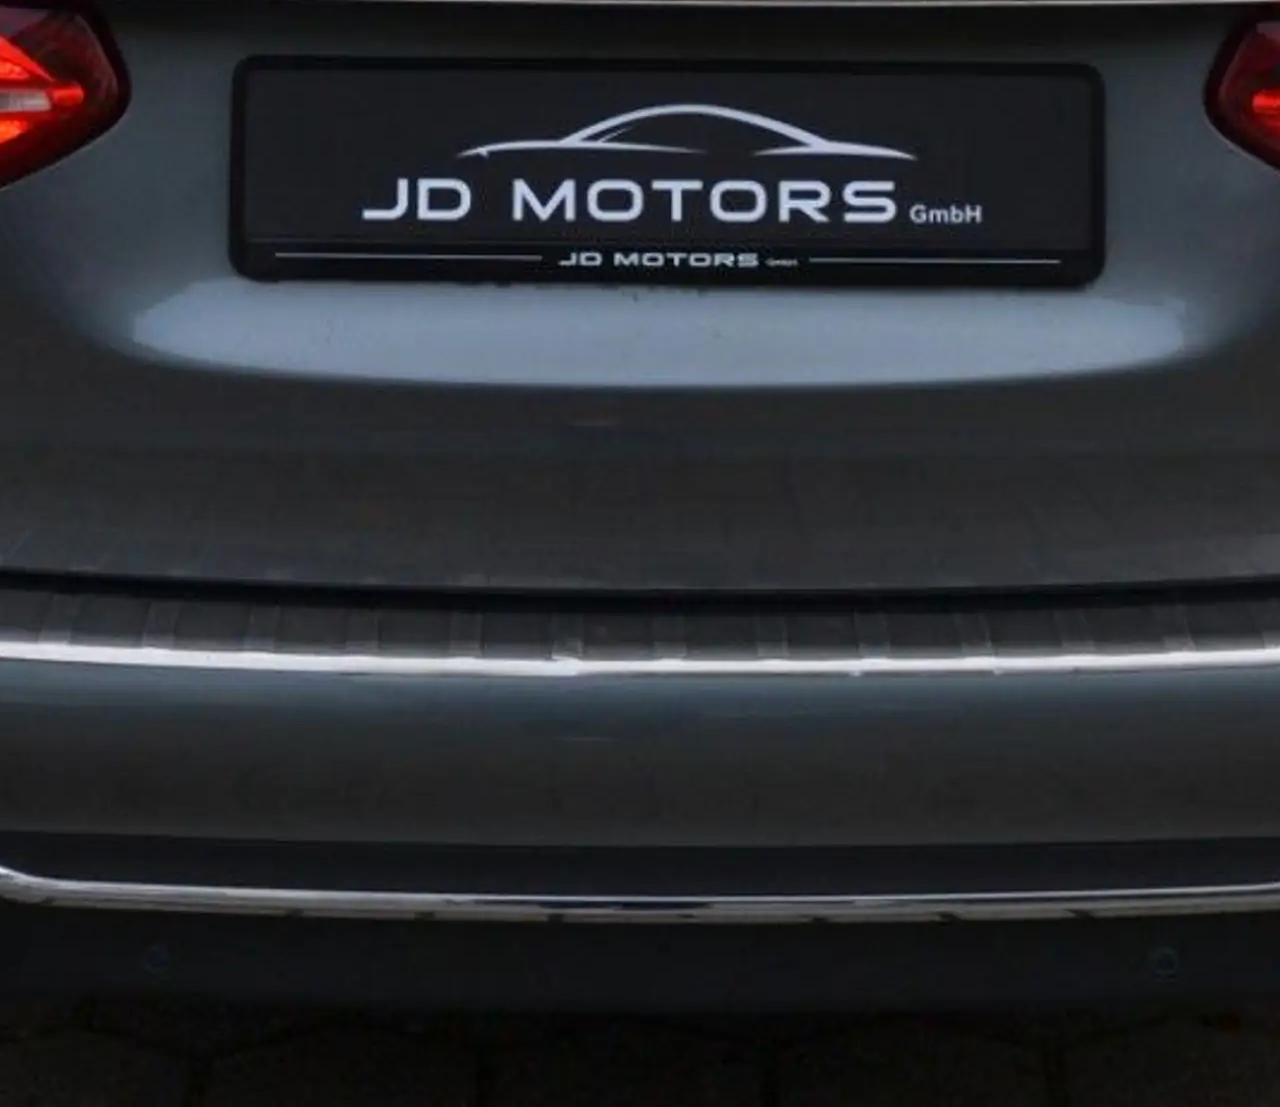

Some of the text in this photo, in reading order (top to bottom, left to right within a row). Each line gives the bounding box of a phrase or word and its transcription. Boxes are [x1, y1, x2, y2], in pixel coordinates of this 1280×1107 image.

[362, 177, 983, 225] JD MOTORS GmbH
[558, 251, 604, 267] JD
[613, 252, 760, 268] MOTORS
